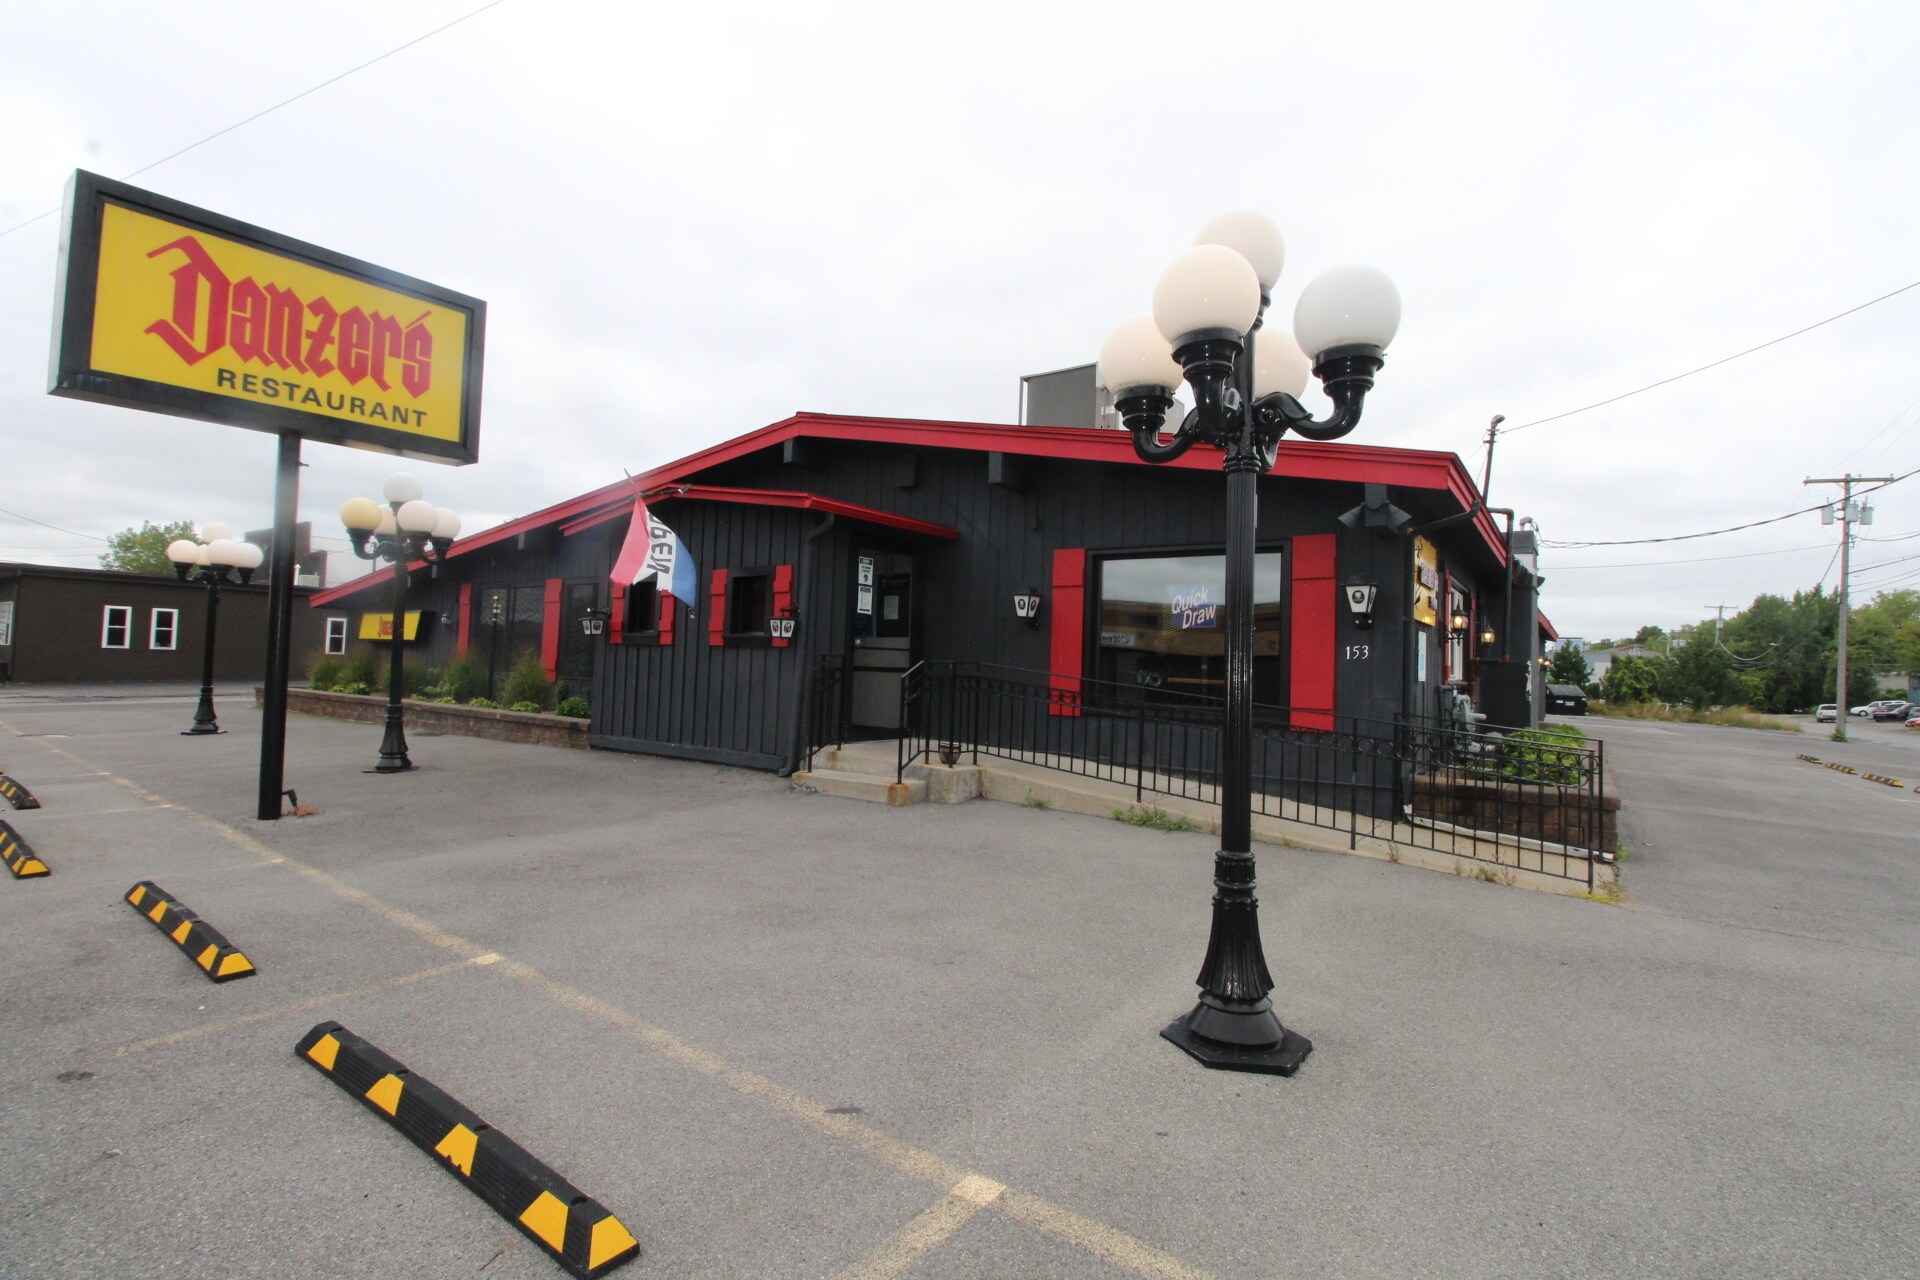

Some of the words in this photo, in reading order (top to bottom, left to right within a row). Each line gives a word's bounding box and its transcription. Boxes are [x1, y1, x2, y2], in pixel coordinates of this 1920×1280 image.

[217, 368, 427, 428] RESTAURANT
[1172, 586, 1208, 614] Quick
[1182, 604, 1217, 629] Draw
[1346, 645, 1369, 660] 153
